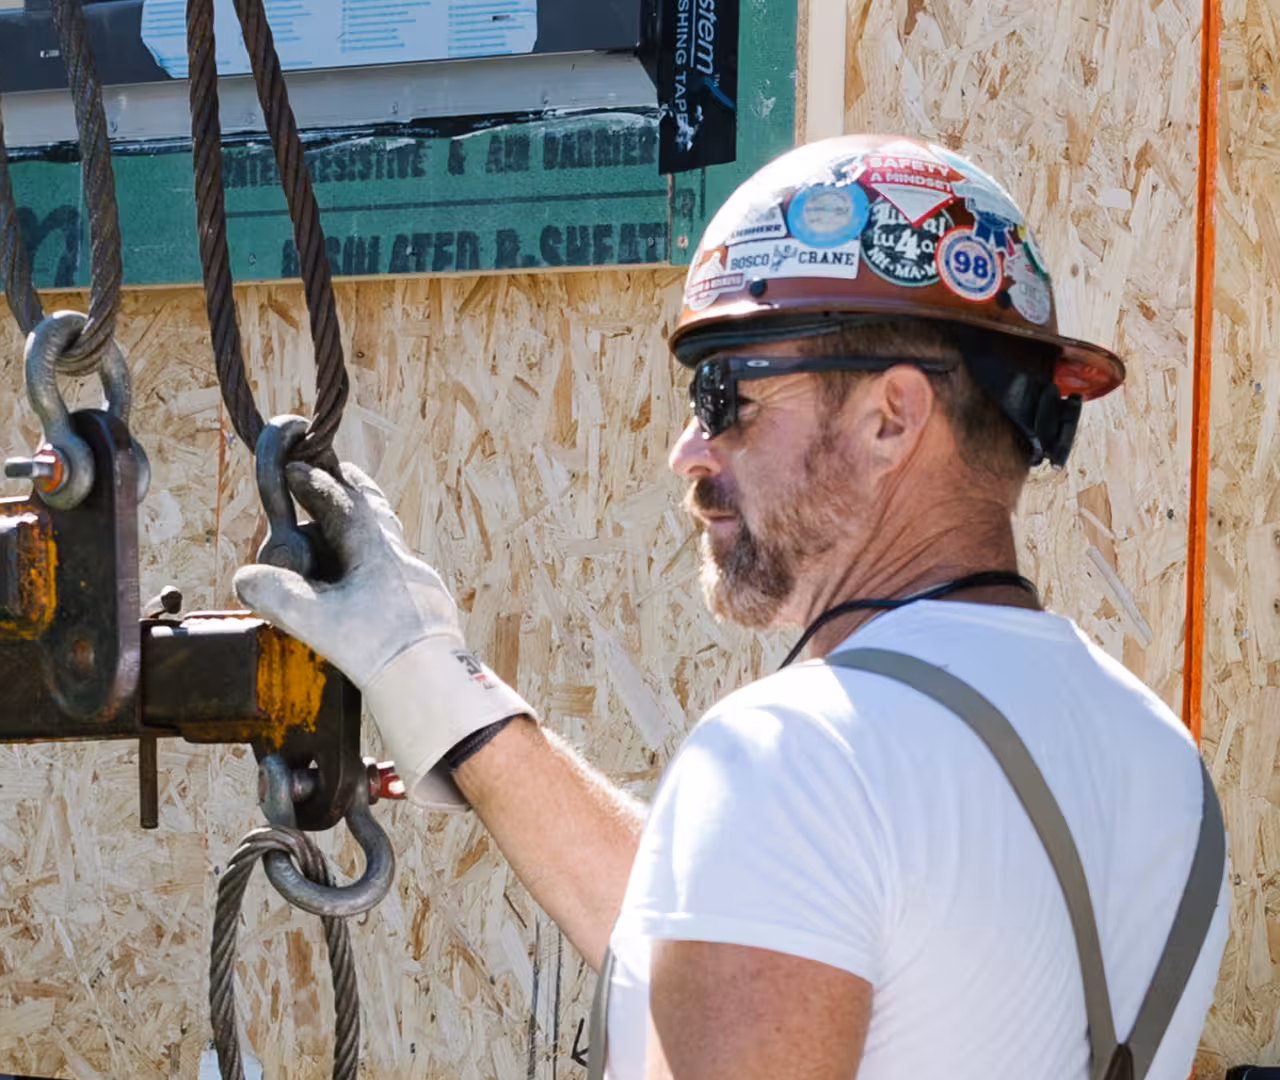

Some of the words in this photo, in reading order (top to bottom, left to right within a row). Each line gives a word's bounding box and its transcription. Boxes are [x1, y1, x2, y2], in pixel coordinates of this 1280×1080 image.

[870, 156, 950, 175] SAFETY
[871, 172, 883, 183] A
[730, 253, 770, 271] BOSCO
[798, 251, 855, 266] CRANE
[953, 250, 989, 279] 98
